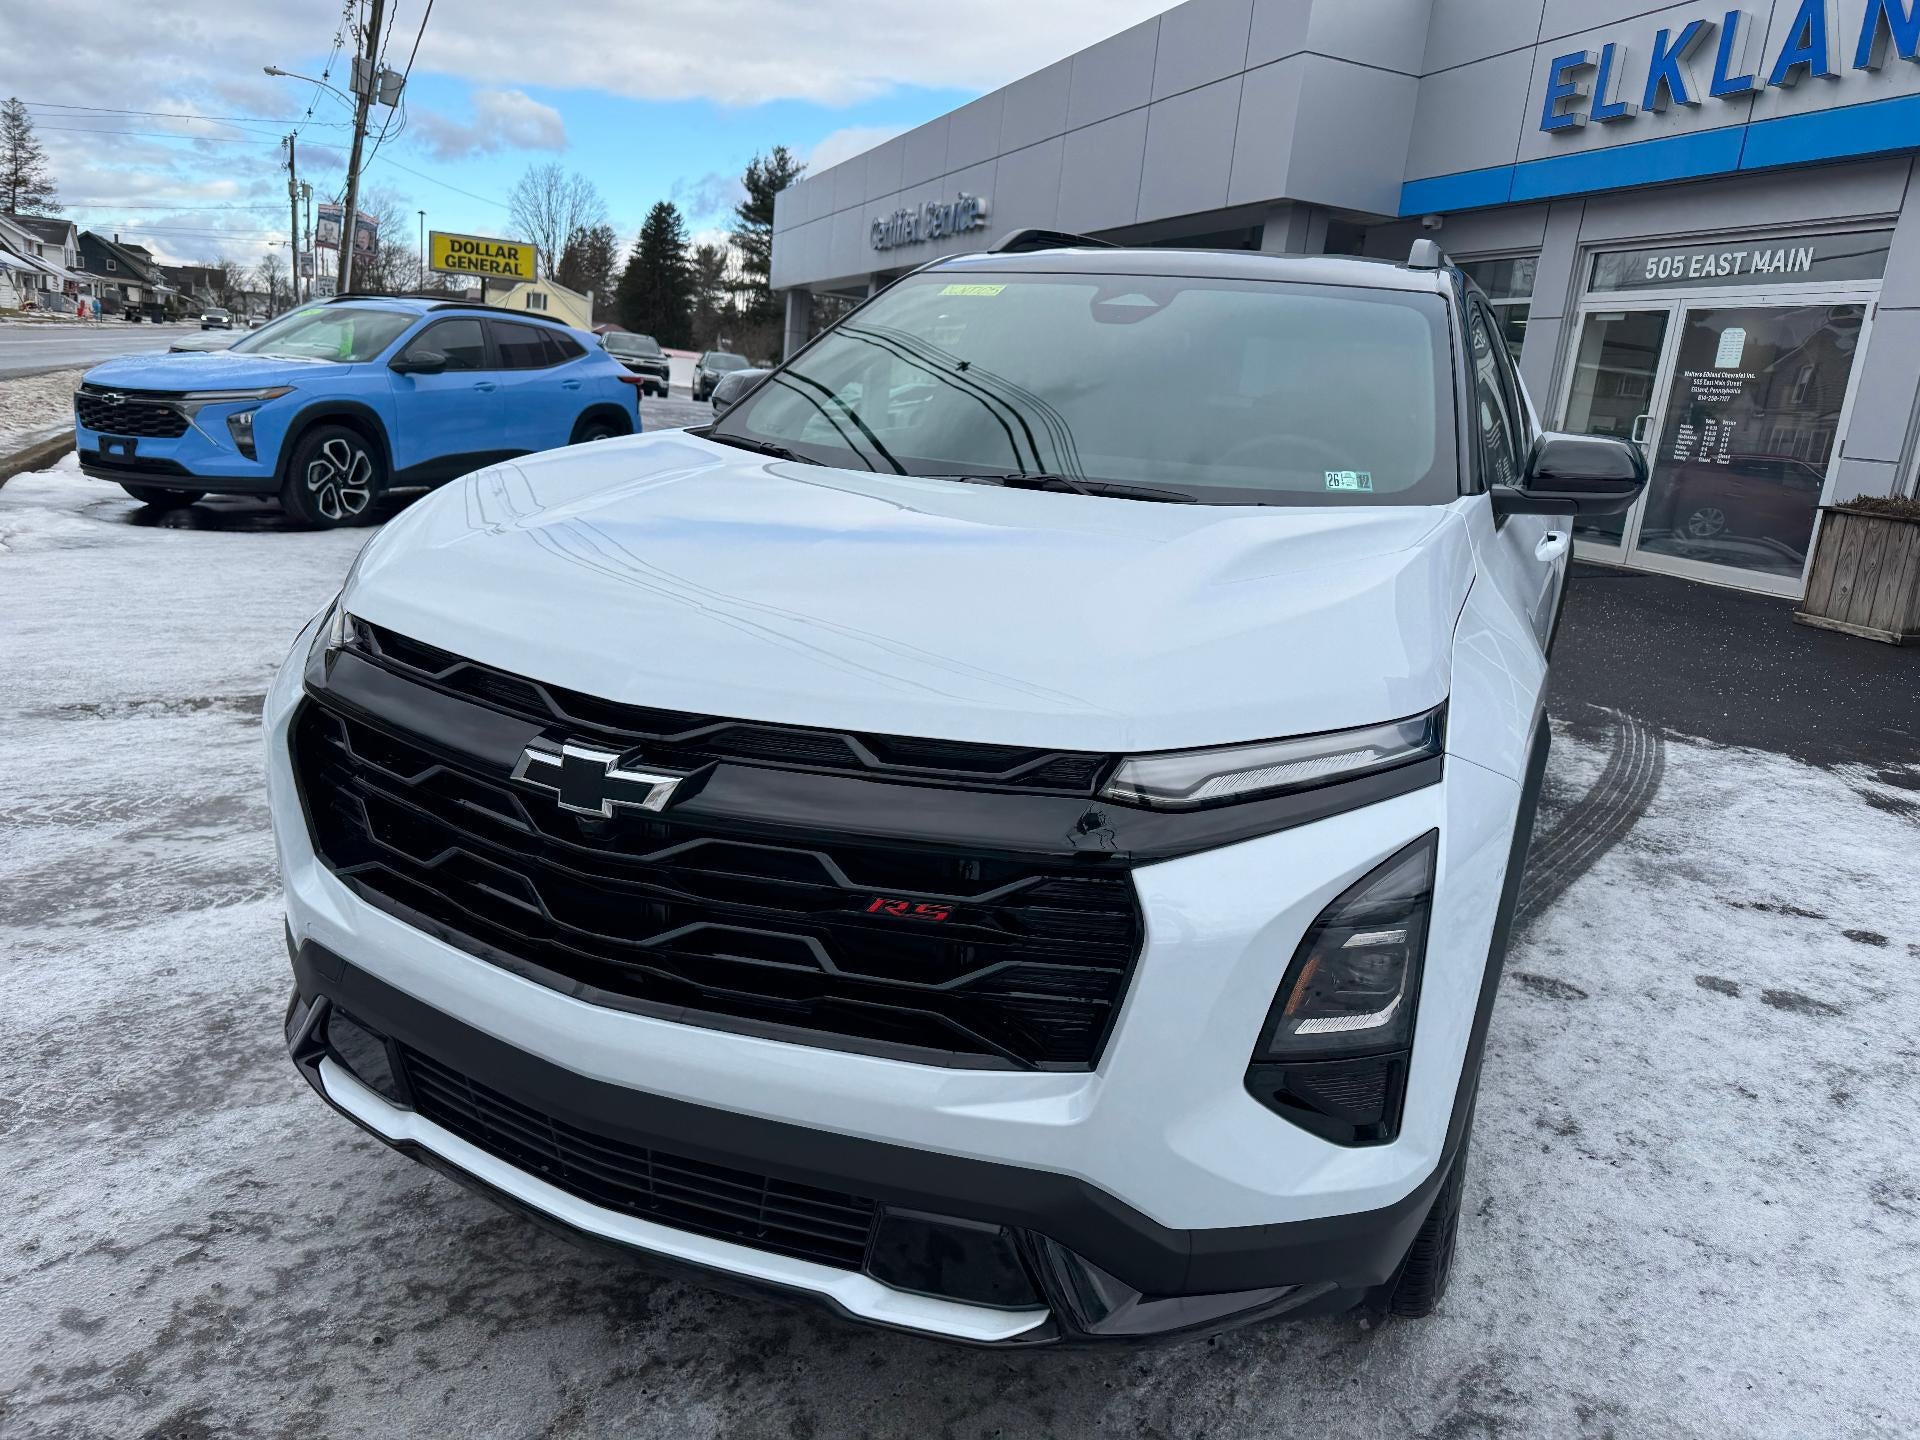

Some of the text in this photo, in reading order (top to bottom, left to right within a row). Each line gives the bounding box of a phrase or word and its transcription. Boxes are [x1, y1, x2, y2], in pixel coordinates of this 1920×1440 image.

[449, 239, 519, 261] DOLLAR
[444, 254, 523, 276] GENERAL
[1645, 247, 1814, 279] 505 EAST MAIN
[319, 287, 335, 297] 35
[1327, 473, 1340, 487] 26
[866, 897, 952, 921] RS
